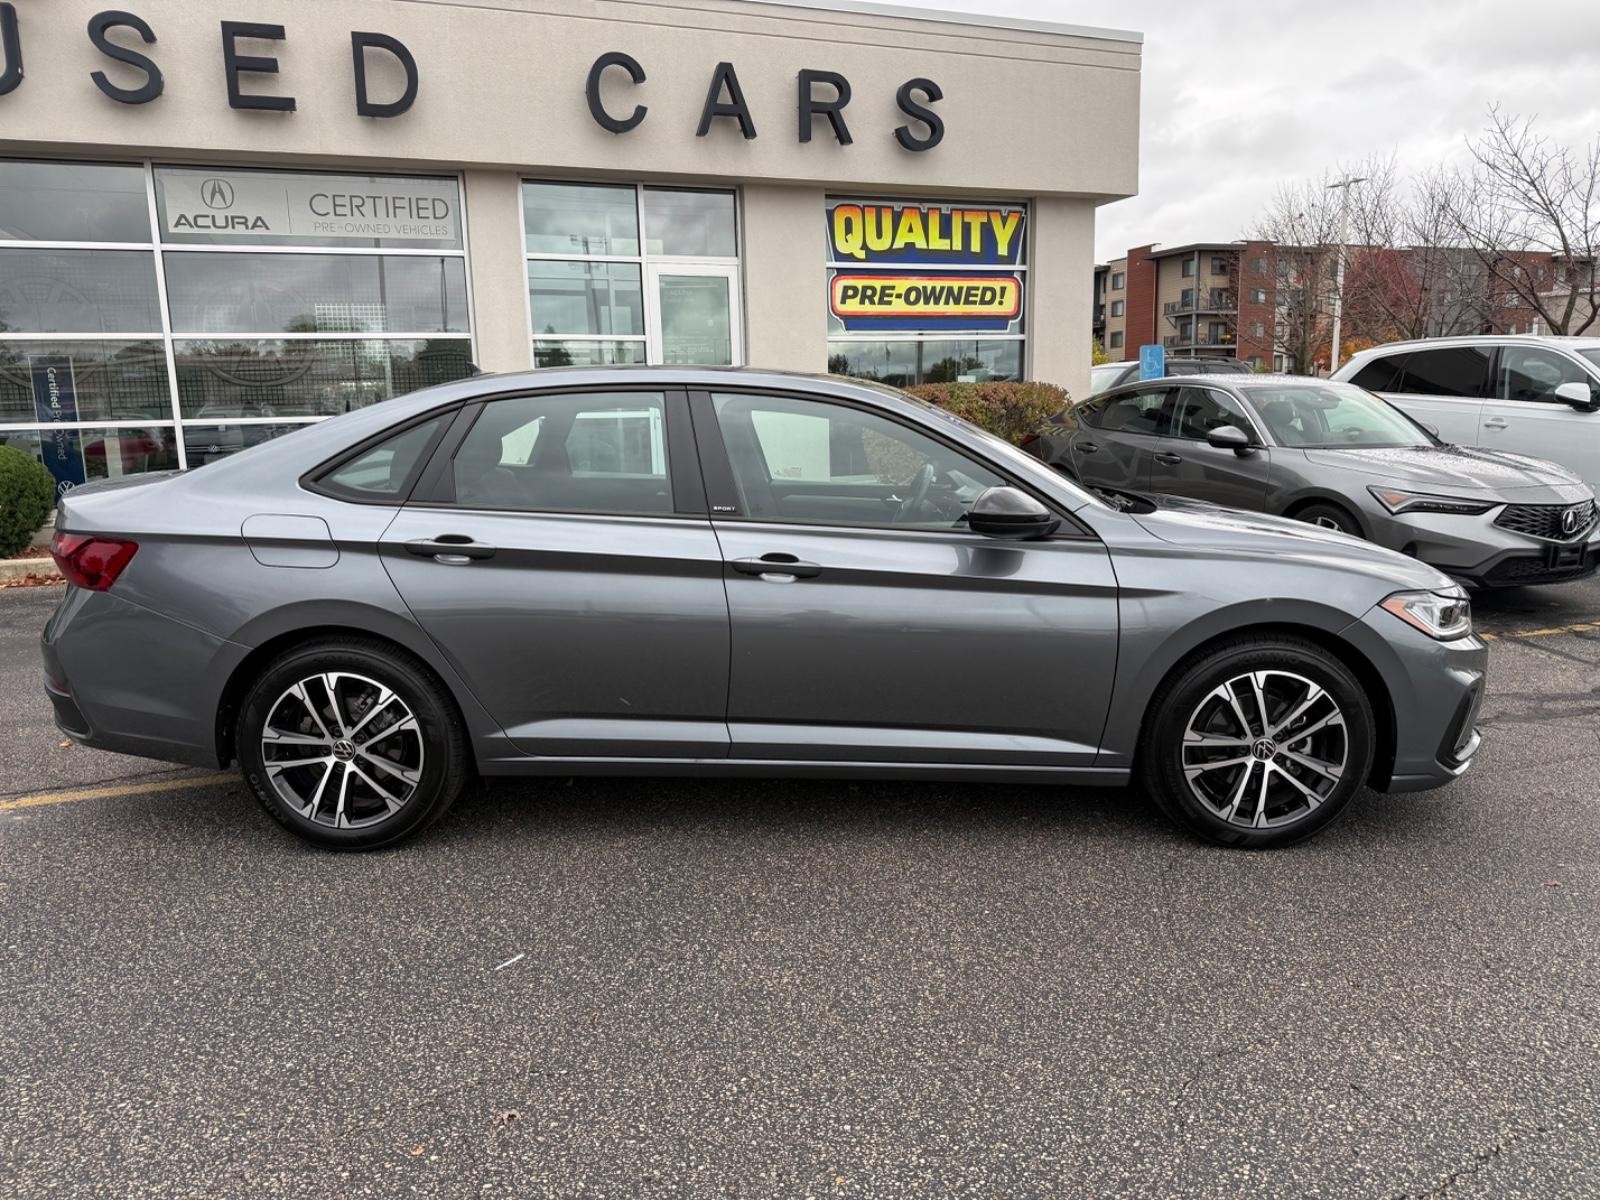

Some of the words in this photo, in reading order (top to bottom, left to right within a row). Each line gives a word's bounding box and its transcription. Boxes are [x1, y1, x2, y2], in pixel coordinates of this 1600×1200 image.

[586, 52, 946, 152] CARS
[309, 193, 450, 220] CERTIFIED
[173, 213, 271, 231] ACURA
[313, 221, 391, 234] PRE-OWNED
[396, 223, 449, 236] VEHICLES
[834, 203, 1022, 260] QUALITY
[840, 284, 1007, 306] PRE-OWNED!
[47, 367, 61, 408] Certified
